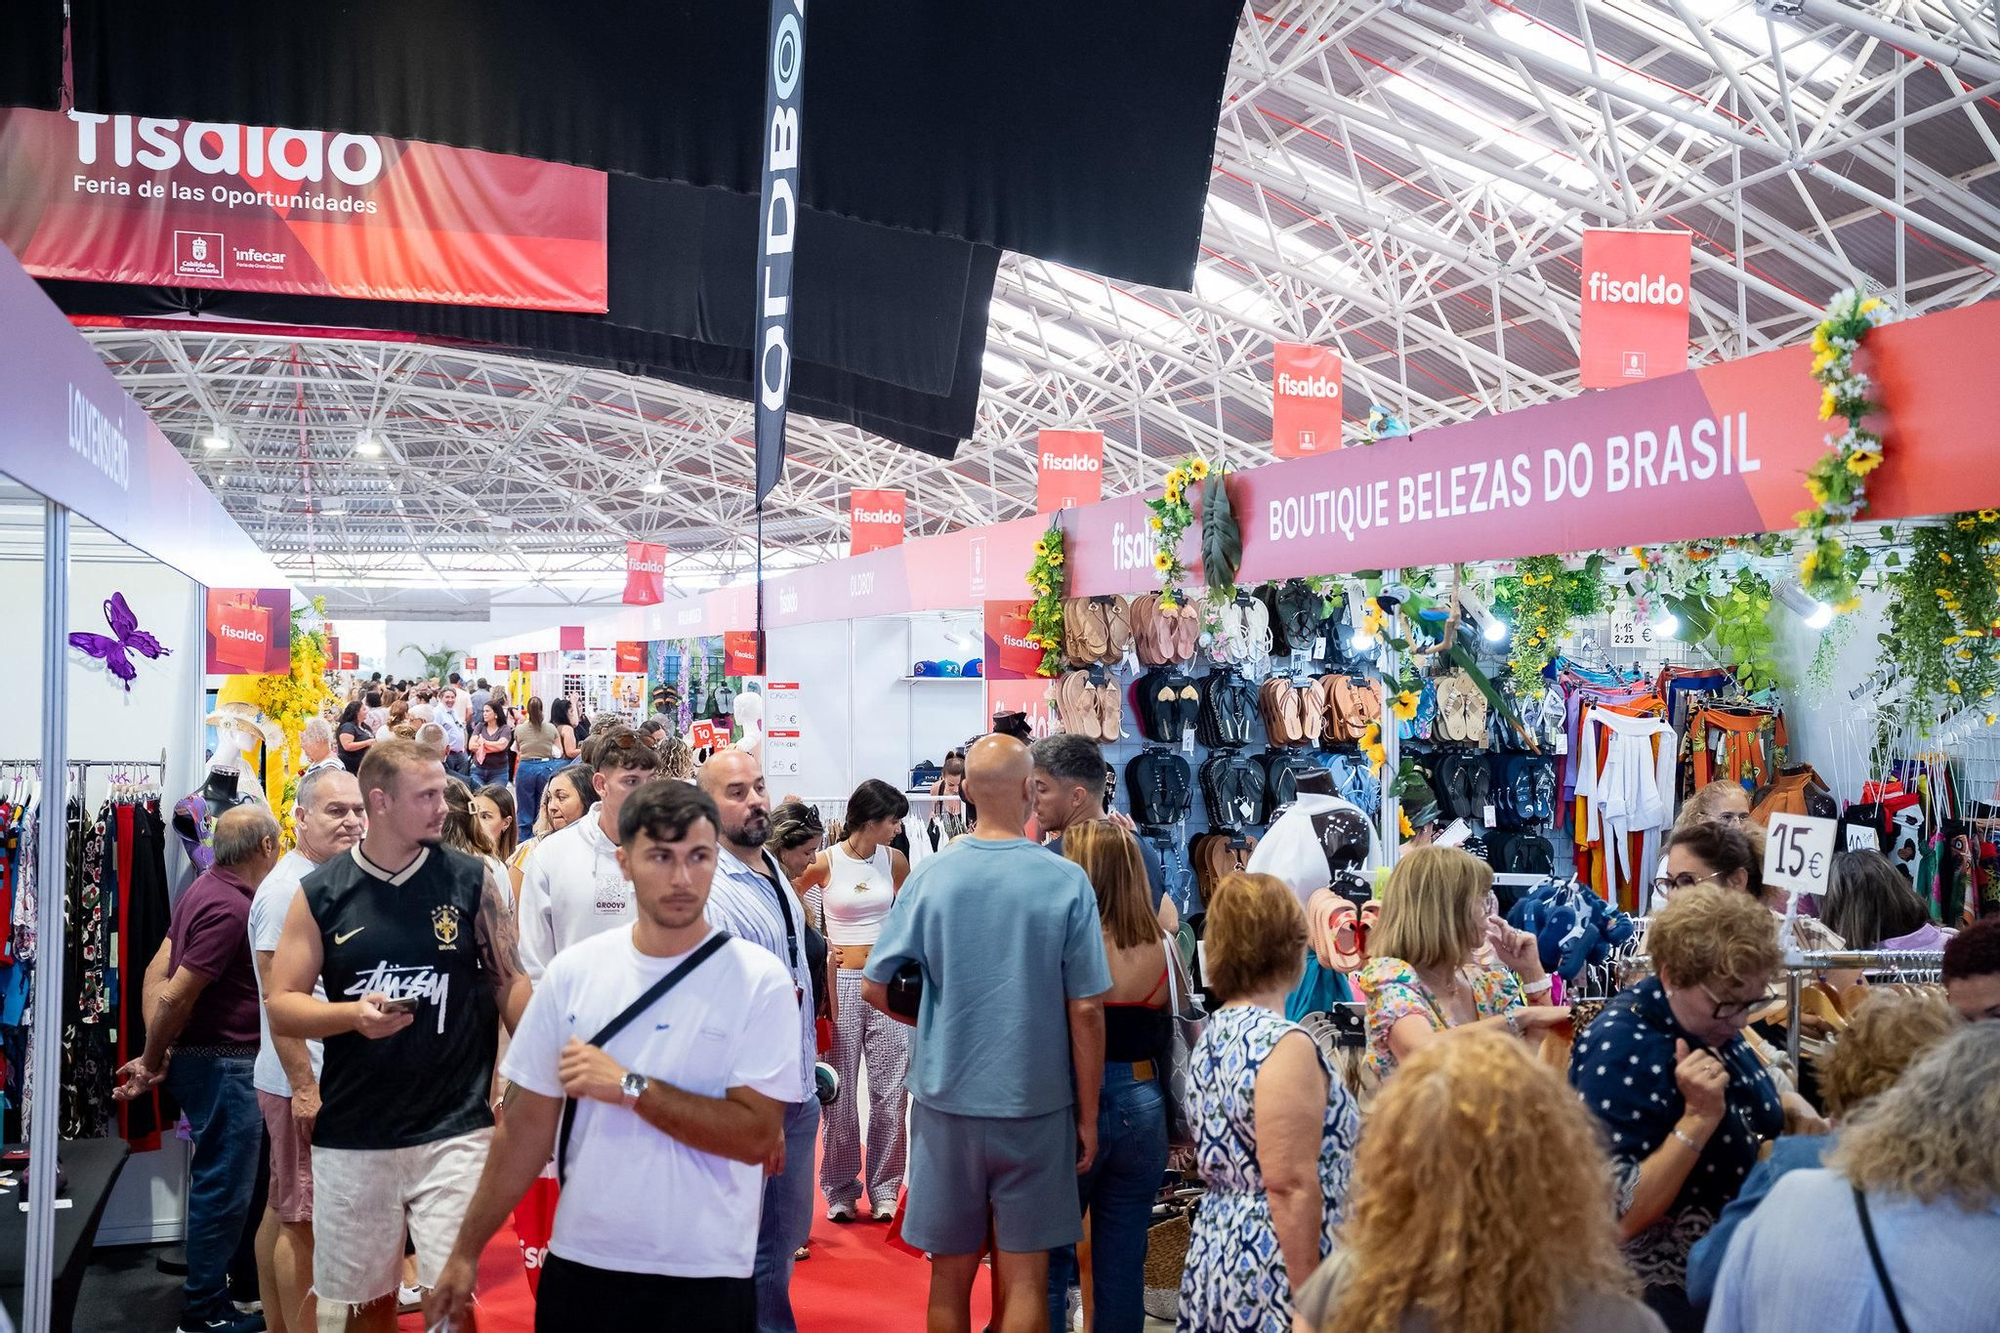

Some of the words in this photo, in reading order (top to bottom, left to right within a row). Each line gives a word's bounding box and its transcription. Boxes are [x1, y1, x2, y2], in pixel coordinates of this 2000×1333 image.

[74, 174, 131, 196] Feria
[137, 179, 165, 199] de
[172, 181, 205, 201] las
[211, 185, 378, 214] Oportunidades
[762, 0, 803, 411] OLDBO
[182, 260, 206, 268] Cabildo
[233, 247, 286, 263] infecar
[1588, 271, 1684, 305] fisaldo
[1278, 372, 1338, 398] fisaldo
[1041, 453, 1099, 471] fisaldo
[1269, 480, 1390, 541] BOUTIQUE
[1398, 454, 1532, 524] BELEZAS
[1544, 441, 1594, 502] DO
[1606, 411, 1761, 493] BRASIL
[853, 507, 902, 524] fisaldo
[628, 557, 664, 573] fisaldo
[850, 571, 875, 597] OLDBOY
[220, 624, 265, 643] fisaldo
[1641, 628, 1652, 642] €
[789, 715, 797, 724] €
[697, 729, 710, 739] 10
[716, 738, 727, 748] 20
[1772, 823, 1813, 877] 15
[1808, 852, 1823, 879] €
